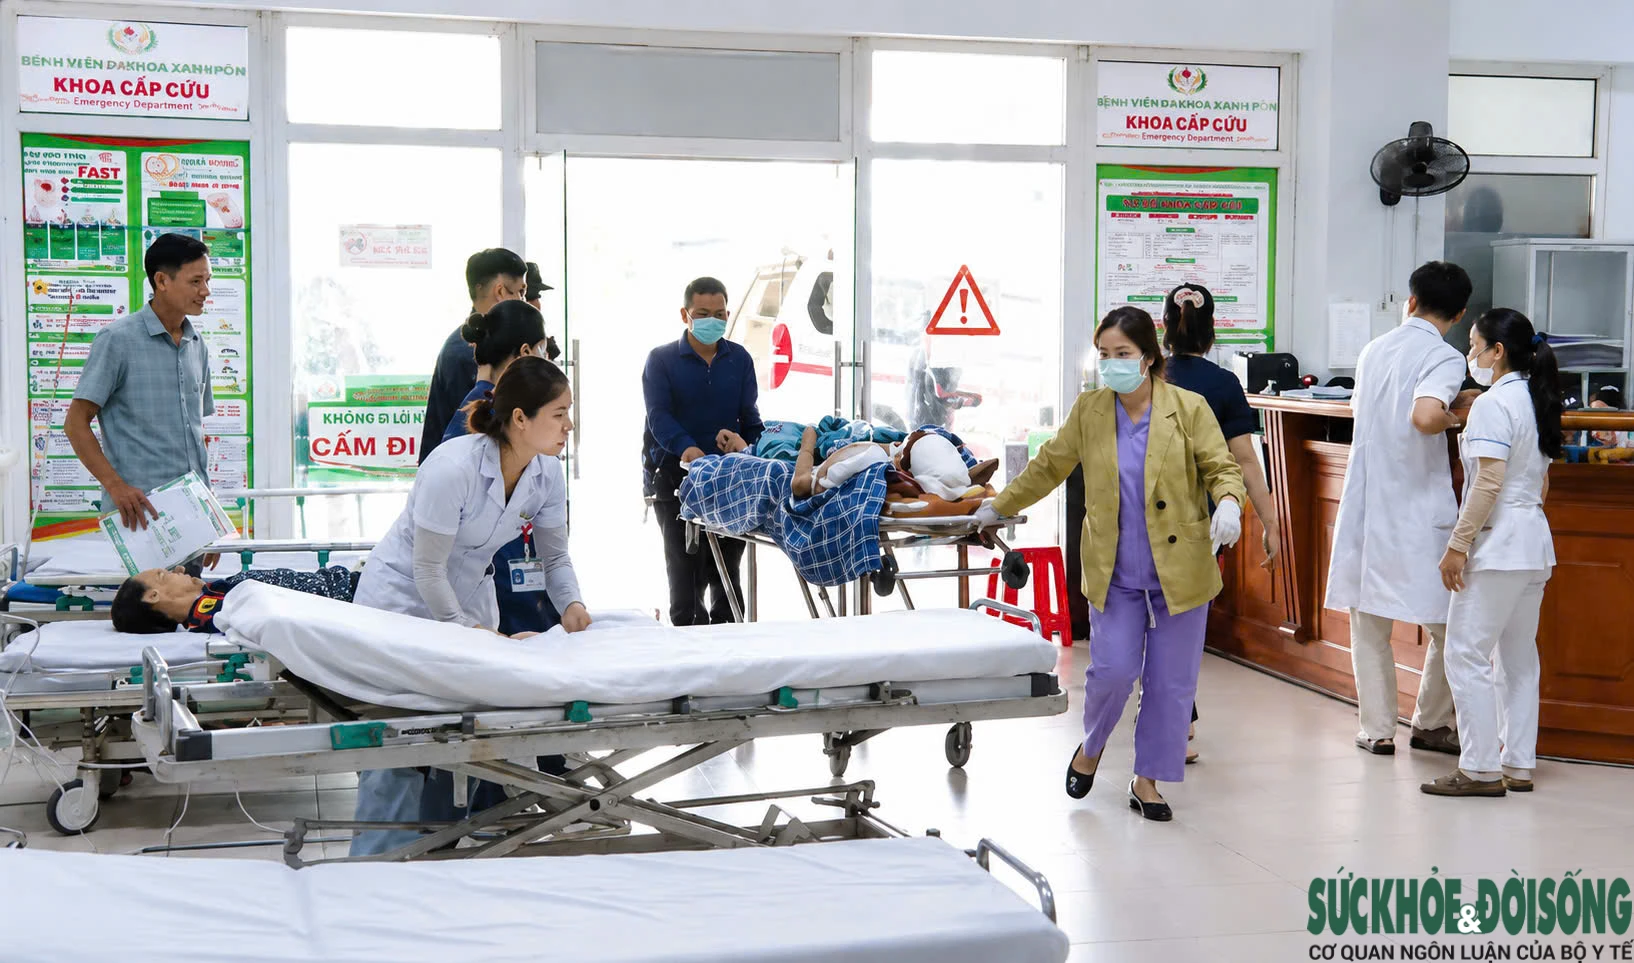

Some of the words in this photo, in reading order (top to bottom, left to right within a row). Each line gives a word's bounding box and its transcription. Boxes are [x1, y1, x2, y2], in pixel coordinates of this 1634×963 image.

[53, 77, 116, 95] KHOA
[119, 75, 162, 97] CẤP
[165, 79, 209, 99] CỨU
[73, 96, 131, 109] Emergency
[133, 99, 193, 111] Department
[1126, 115, 1173, 130] KHOA
[1176, 112, 1210, 131] CẤP
[1212, 115, 1247, 132] CỨU
[1142, 132, 1186, 142] Emergency
[1187, 134, 1234, 143] Department
[78, 166, 121, 180] FAST
[311, 429, 376, 456] CẤM
[386, 437, 415, 456] ĐI
